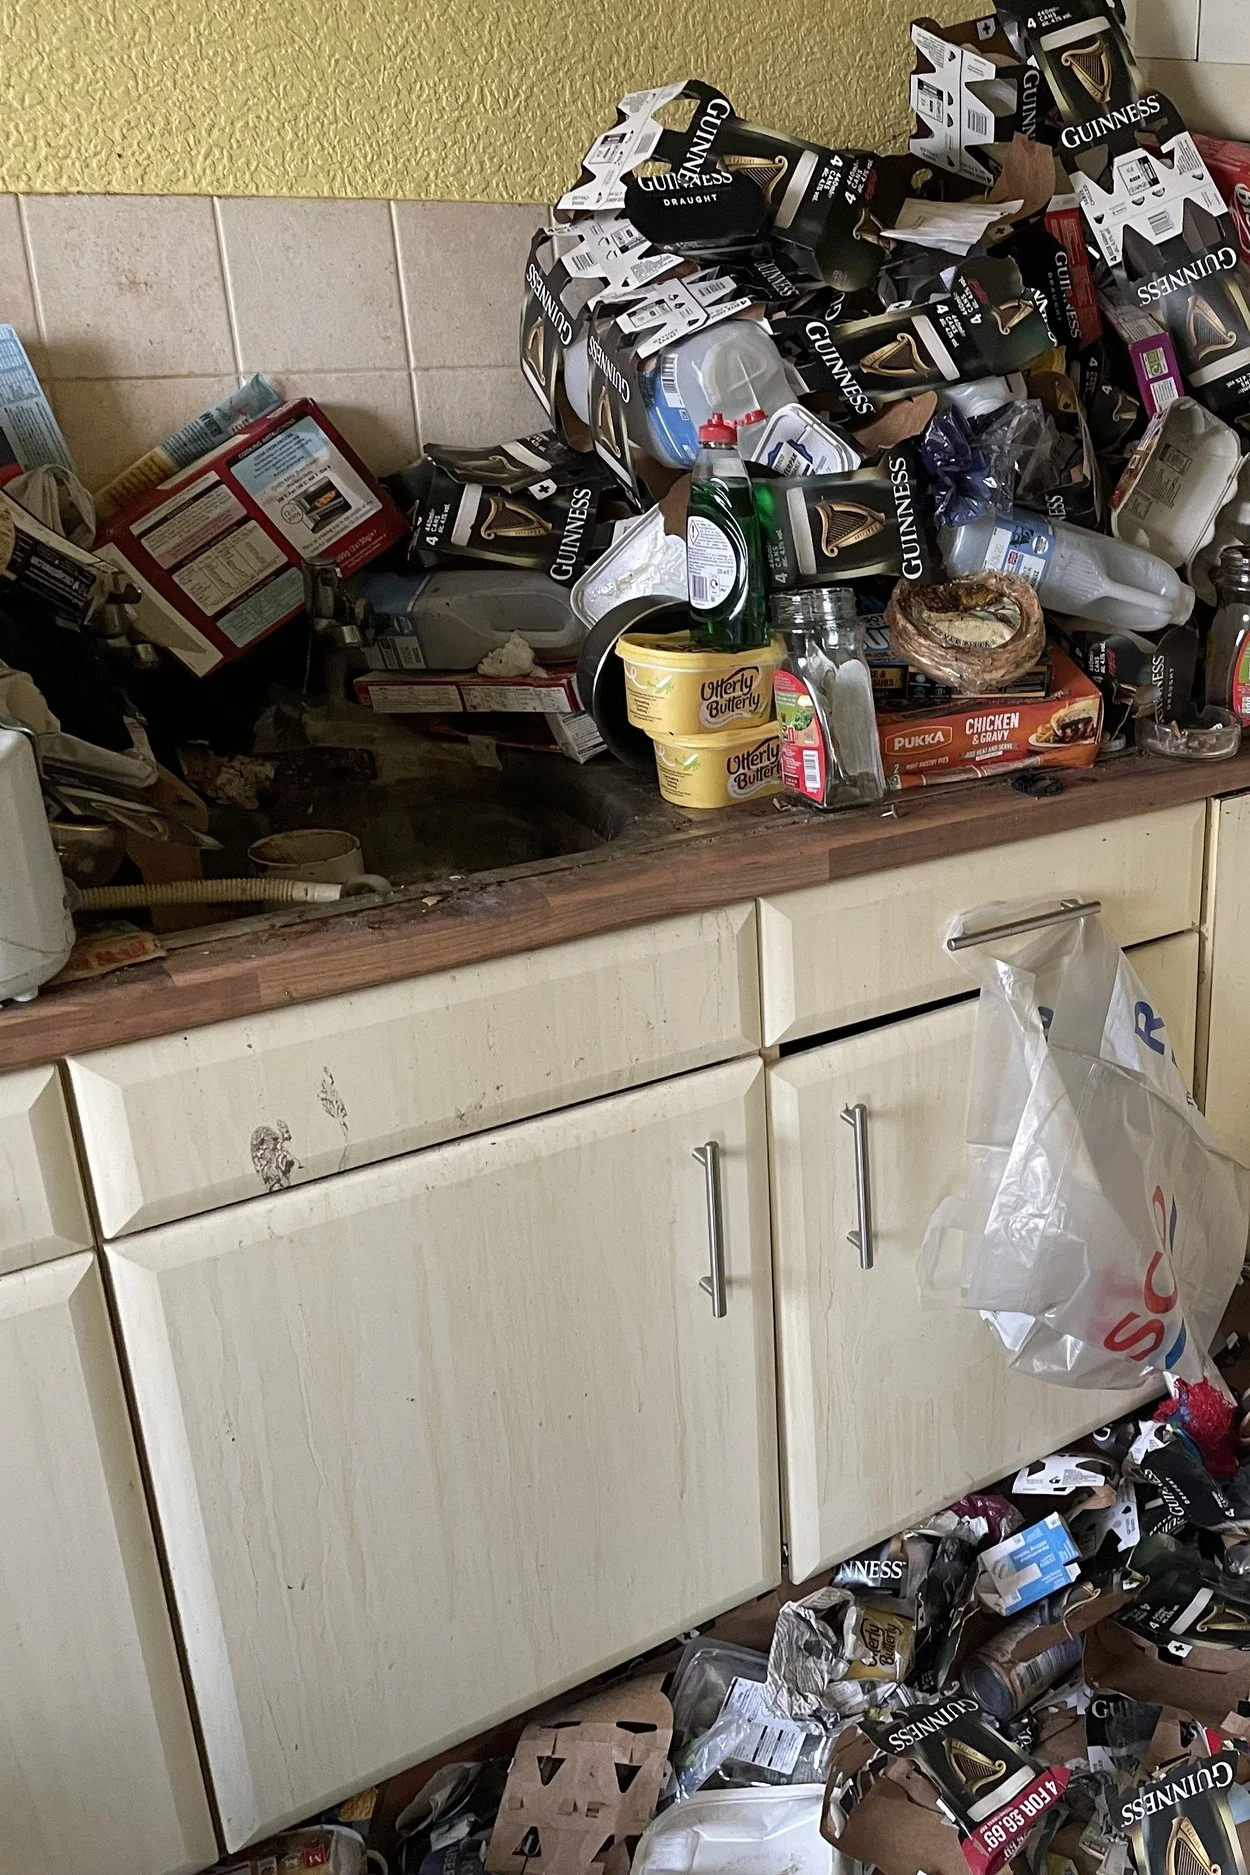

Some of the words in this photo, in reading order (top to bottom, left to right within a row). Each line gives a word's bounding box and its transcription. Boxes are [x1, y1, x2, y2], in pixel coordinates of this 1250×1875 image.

[1028, 18, 1036, 28] 4
[1060, 95, 1161, 148] GUINNESS
[830, 155, 843, 167] 4
[824, 170, 836, 190] CANS
[851, 169, 862, 189] CANS
[663, 194, 718, 206] DRAUGHT
[845, 191, 856, 204] 4
[1137, 246, 1237, 307] GUINNESS
[526, 263, 573, 346] GUINNESS
[936, 304, 949, 314] 4
[970, 313, 982, 324] 4
[588, 336, 631, 404] GUINNESS
[805, 321, 876, 415] GUINNESS
[1088, 356, 1098, 367] 4
[1101, 384, 1113, 395] 4
[238, 440, 262, 459] COOKING
[889, 455, 923, 580] GUINNESS
[426, 536, 438, 545] 4
[550, 488, 592, 581] GUINNESS
[775, 572, 788, 583] 4
[700, 666, 760, 701] Utterly
[706, 692, 761, 718] Butterly
[965, 712, 1020, 735] CHICKEN
[894, 731, 945, 750] PUKKA
[972, 734, 979, 745] &
[980, 730, 1009, 743] GRAVY
[726, 735, 779, 775] Utterly
[988, 745, 998, 754] AND
[998, 743, 1013, 751] SERVE
[894, 764, 899, 774] 2
[1224, 1508, 1235, 1517] 4
[1149, 1621, 1159, 1629] 4
[878, 1622, 902, 1666] Butterly
[888, 1698, 979, 1752] GUINNESS
[1044, 1780, 1058, 1796] 4
[1120, 1761, 1234, 1828] GUINNESS
[1019, 1786, 1051, 1817] FOR
